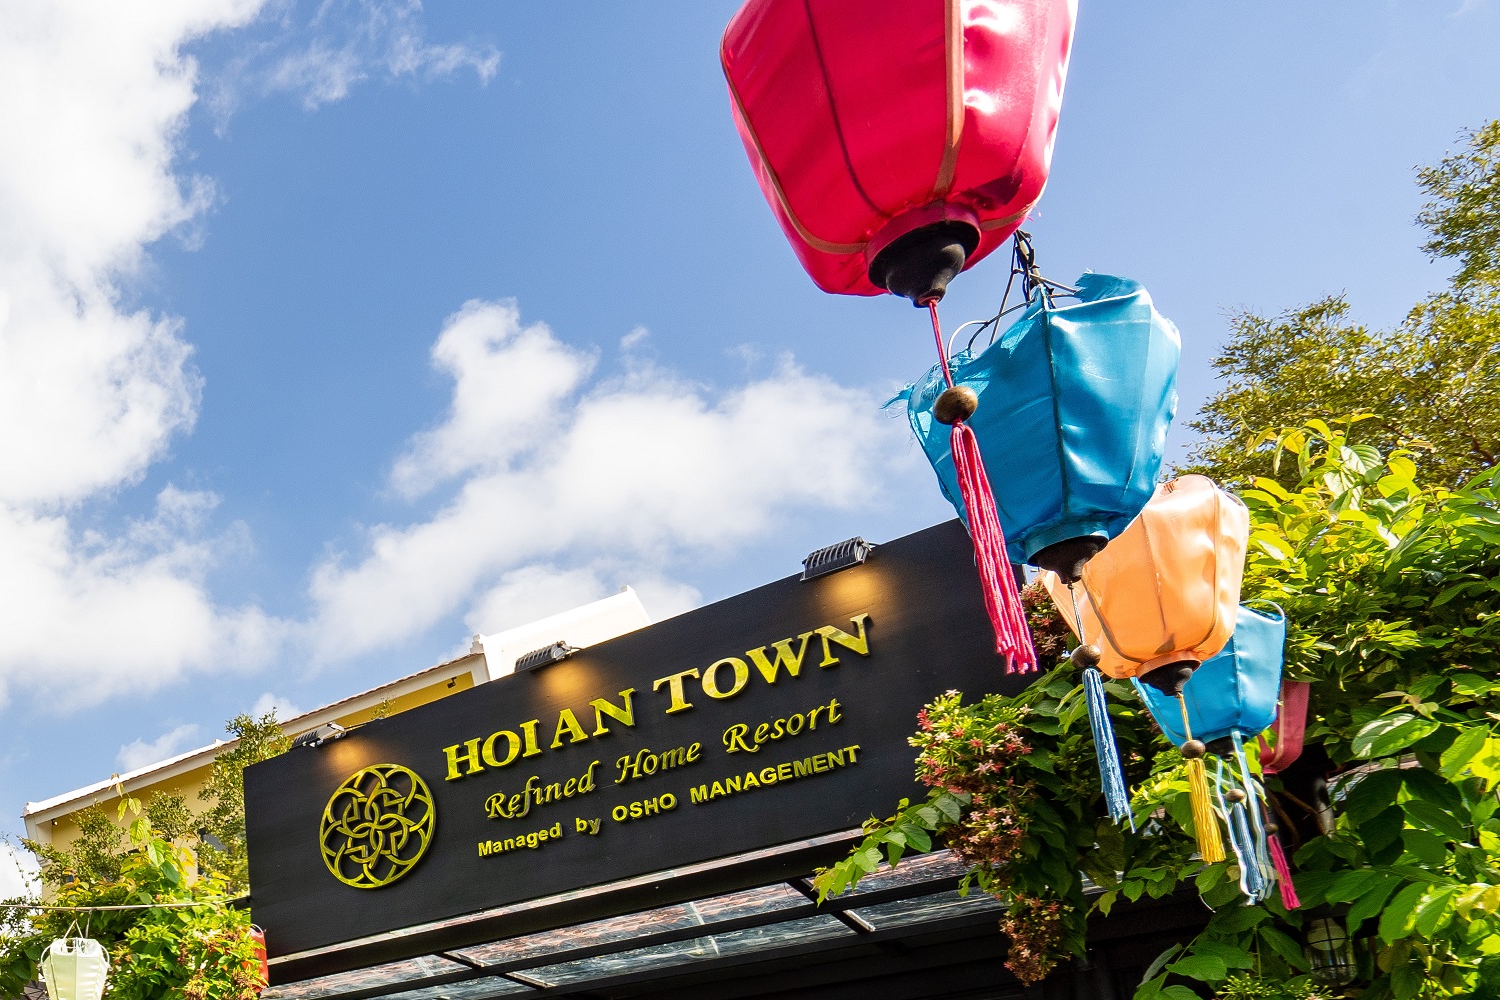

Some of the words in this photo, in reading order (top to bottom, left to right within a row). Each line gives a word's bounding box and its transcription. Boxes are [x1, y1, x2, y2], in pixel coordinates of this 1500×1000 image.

[442, 719, 542, 781] HOI
[550, 687, 636, 749] AN
[653, 612, 870, 714] TOWN
[478, 822, 563, 857] Managed
[575, 817, 601, 835] by
[612, 793, 678, 822] OSHO
[689, 744, 861, 805] MANAGEMENT
[484, 760, 600, 820] Refined
[615, 742, 702, 785] Home
[722, 698, 843, 753] Resort
